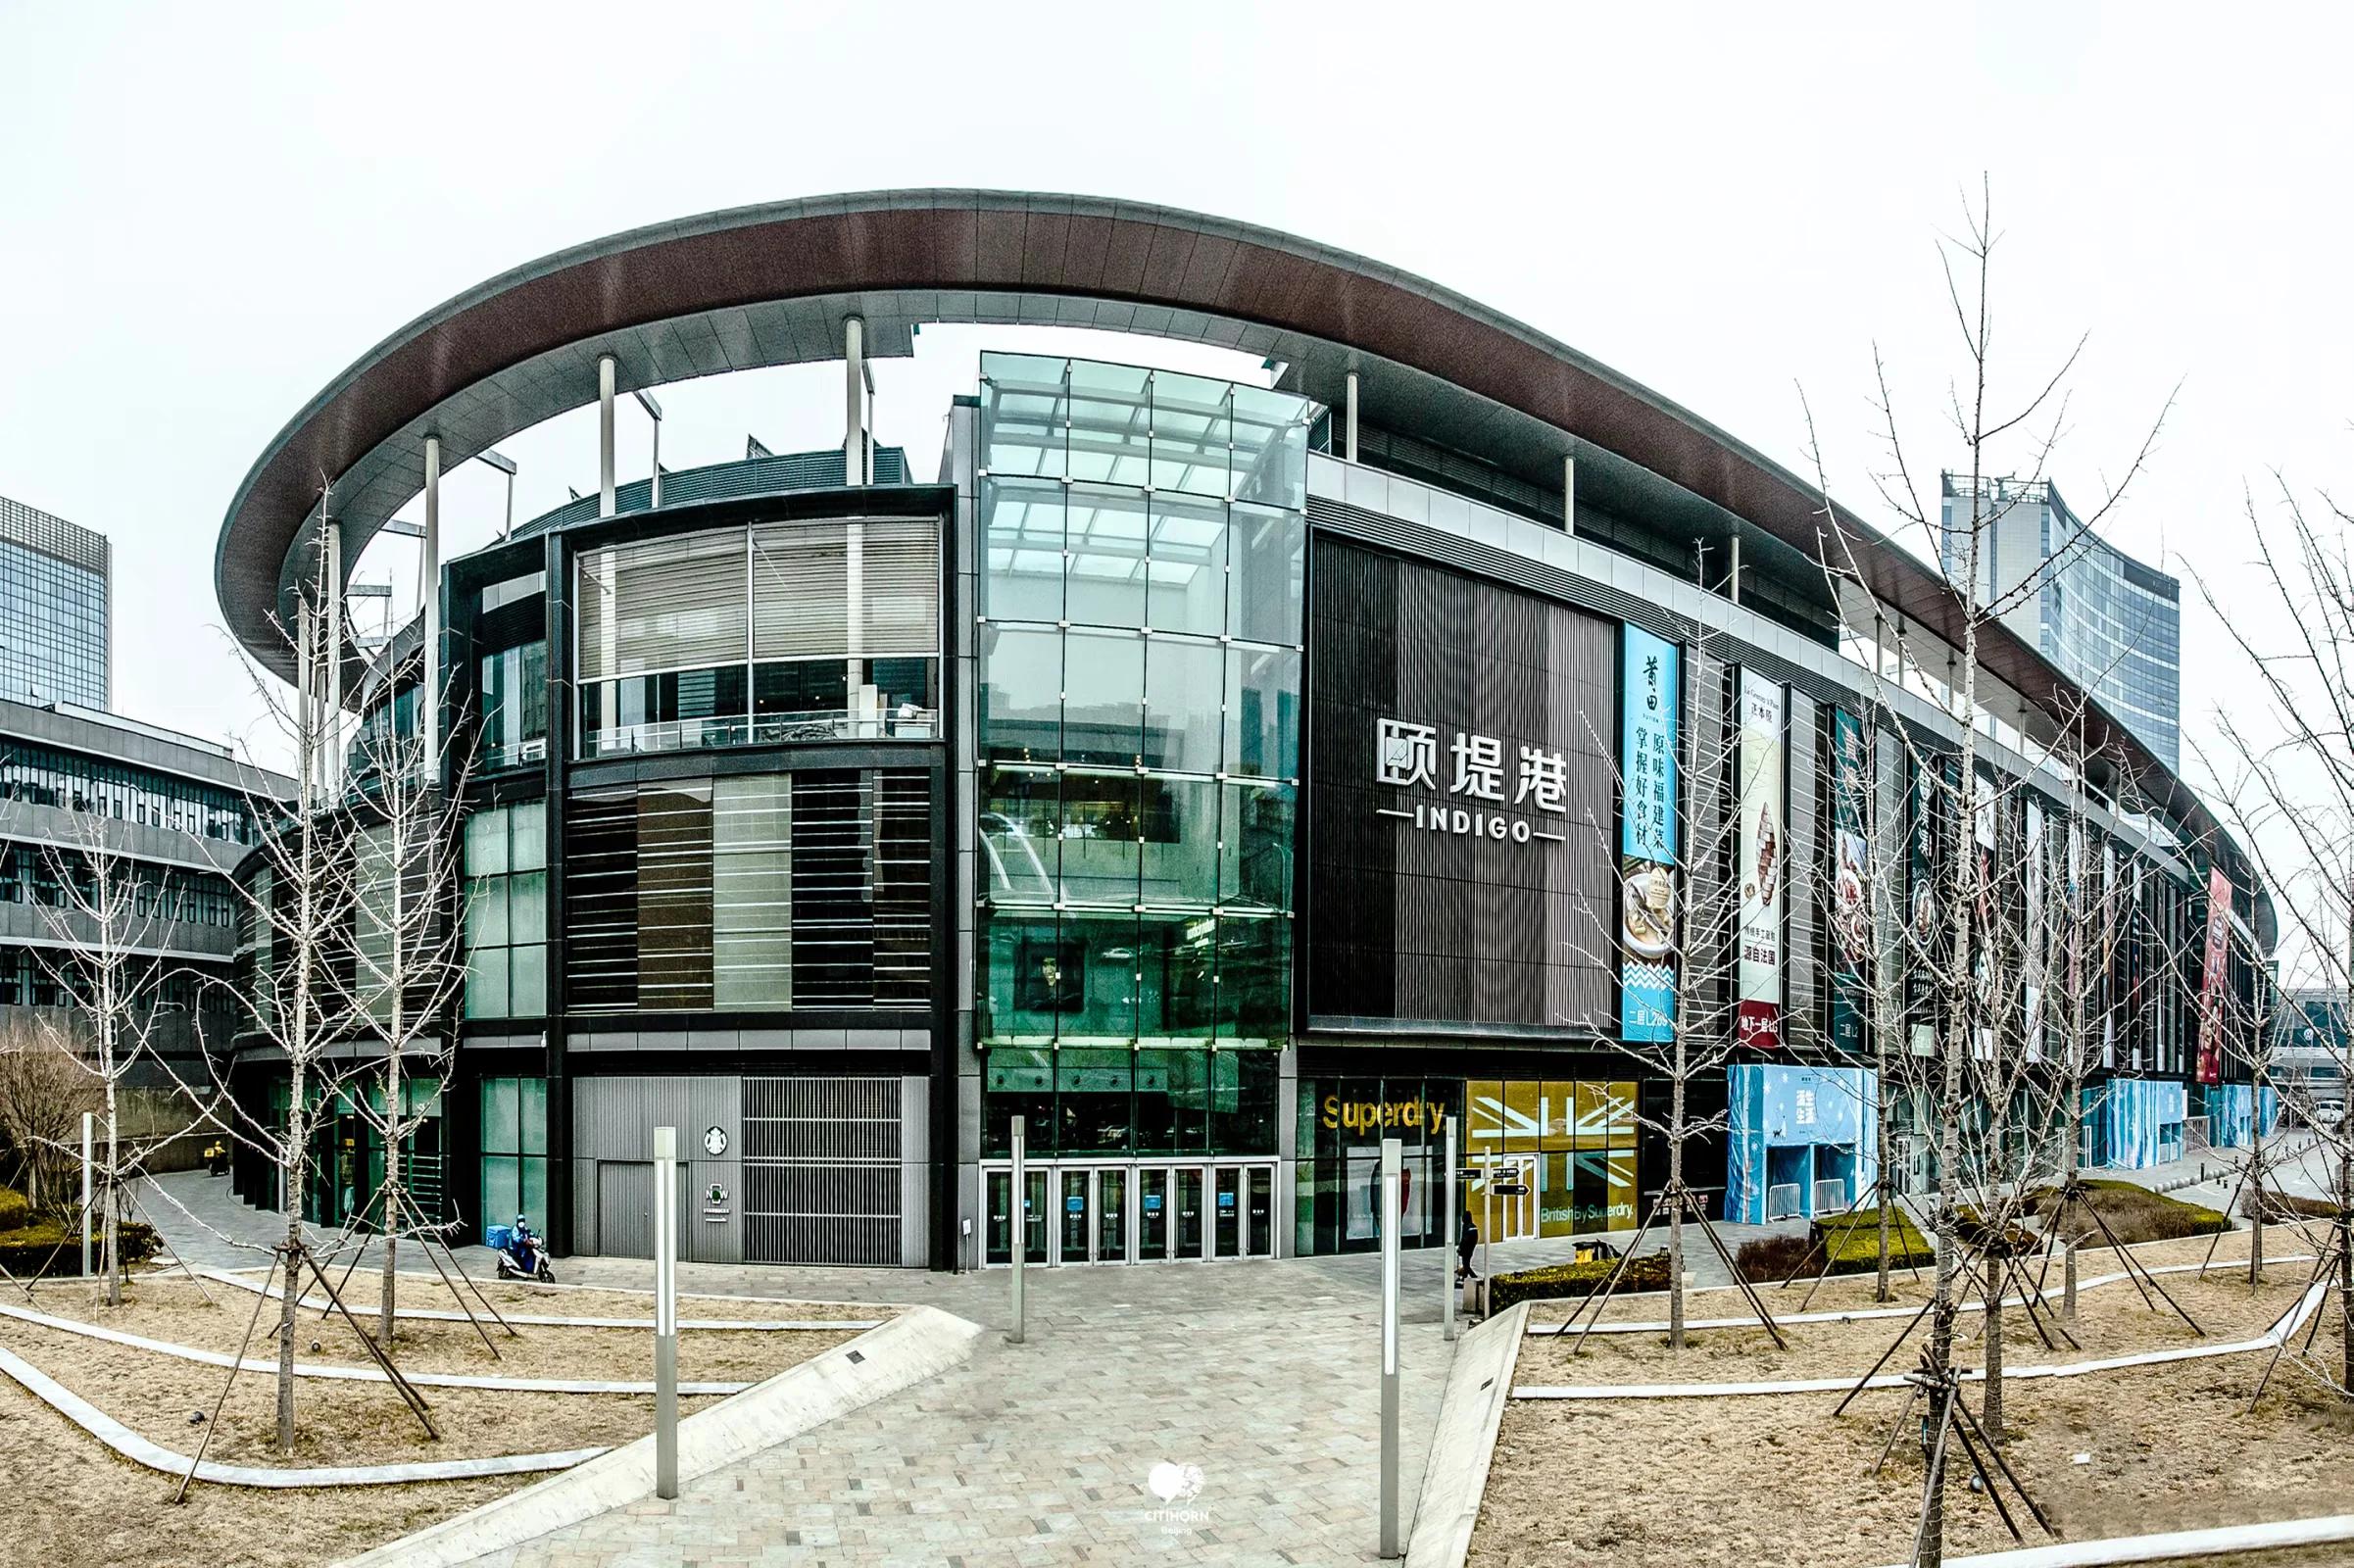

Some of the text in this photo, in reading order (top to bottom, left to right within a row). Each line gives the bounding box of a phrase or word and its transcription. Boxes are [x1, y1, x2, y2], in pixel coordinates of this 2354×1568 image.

[1377, 718, 1567, 812] 颐堤港
[1635, 726, 1647, 846] 掌握好食材
[1416, 805, 1531, 843] INDIGO
[1744, 945, 1776, 965] 源自法国
[1541, 1206, 1573, 1223] British
[1574, 1205, 1588, 1223] By
